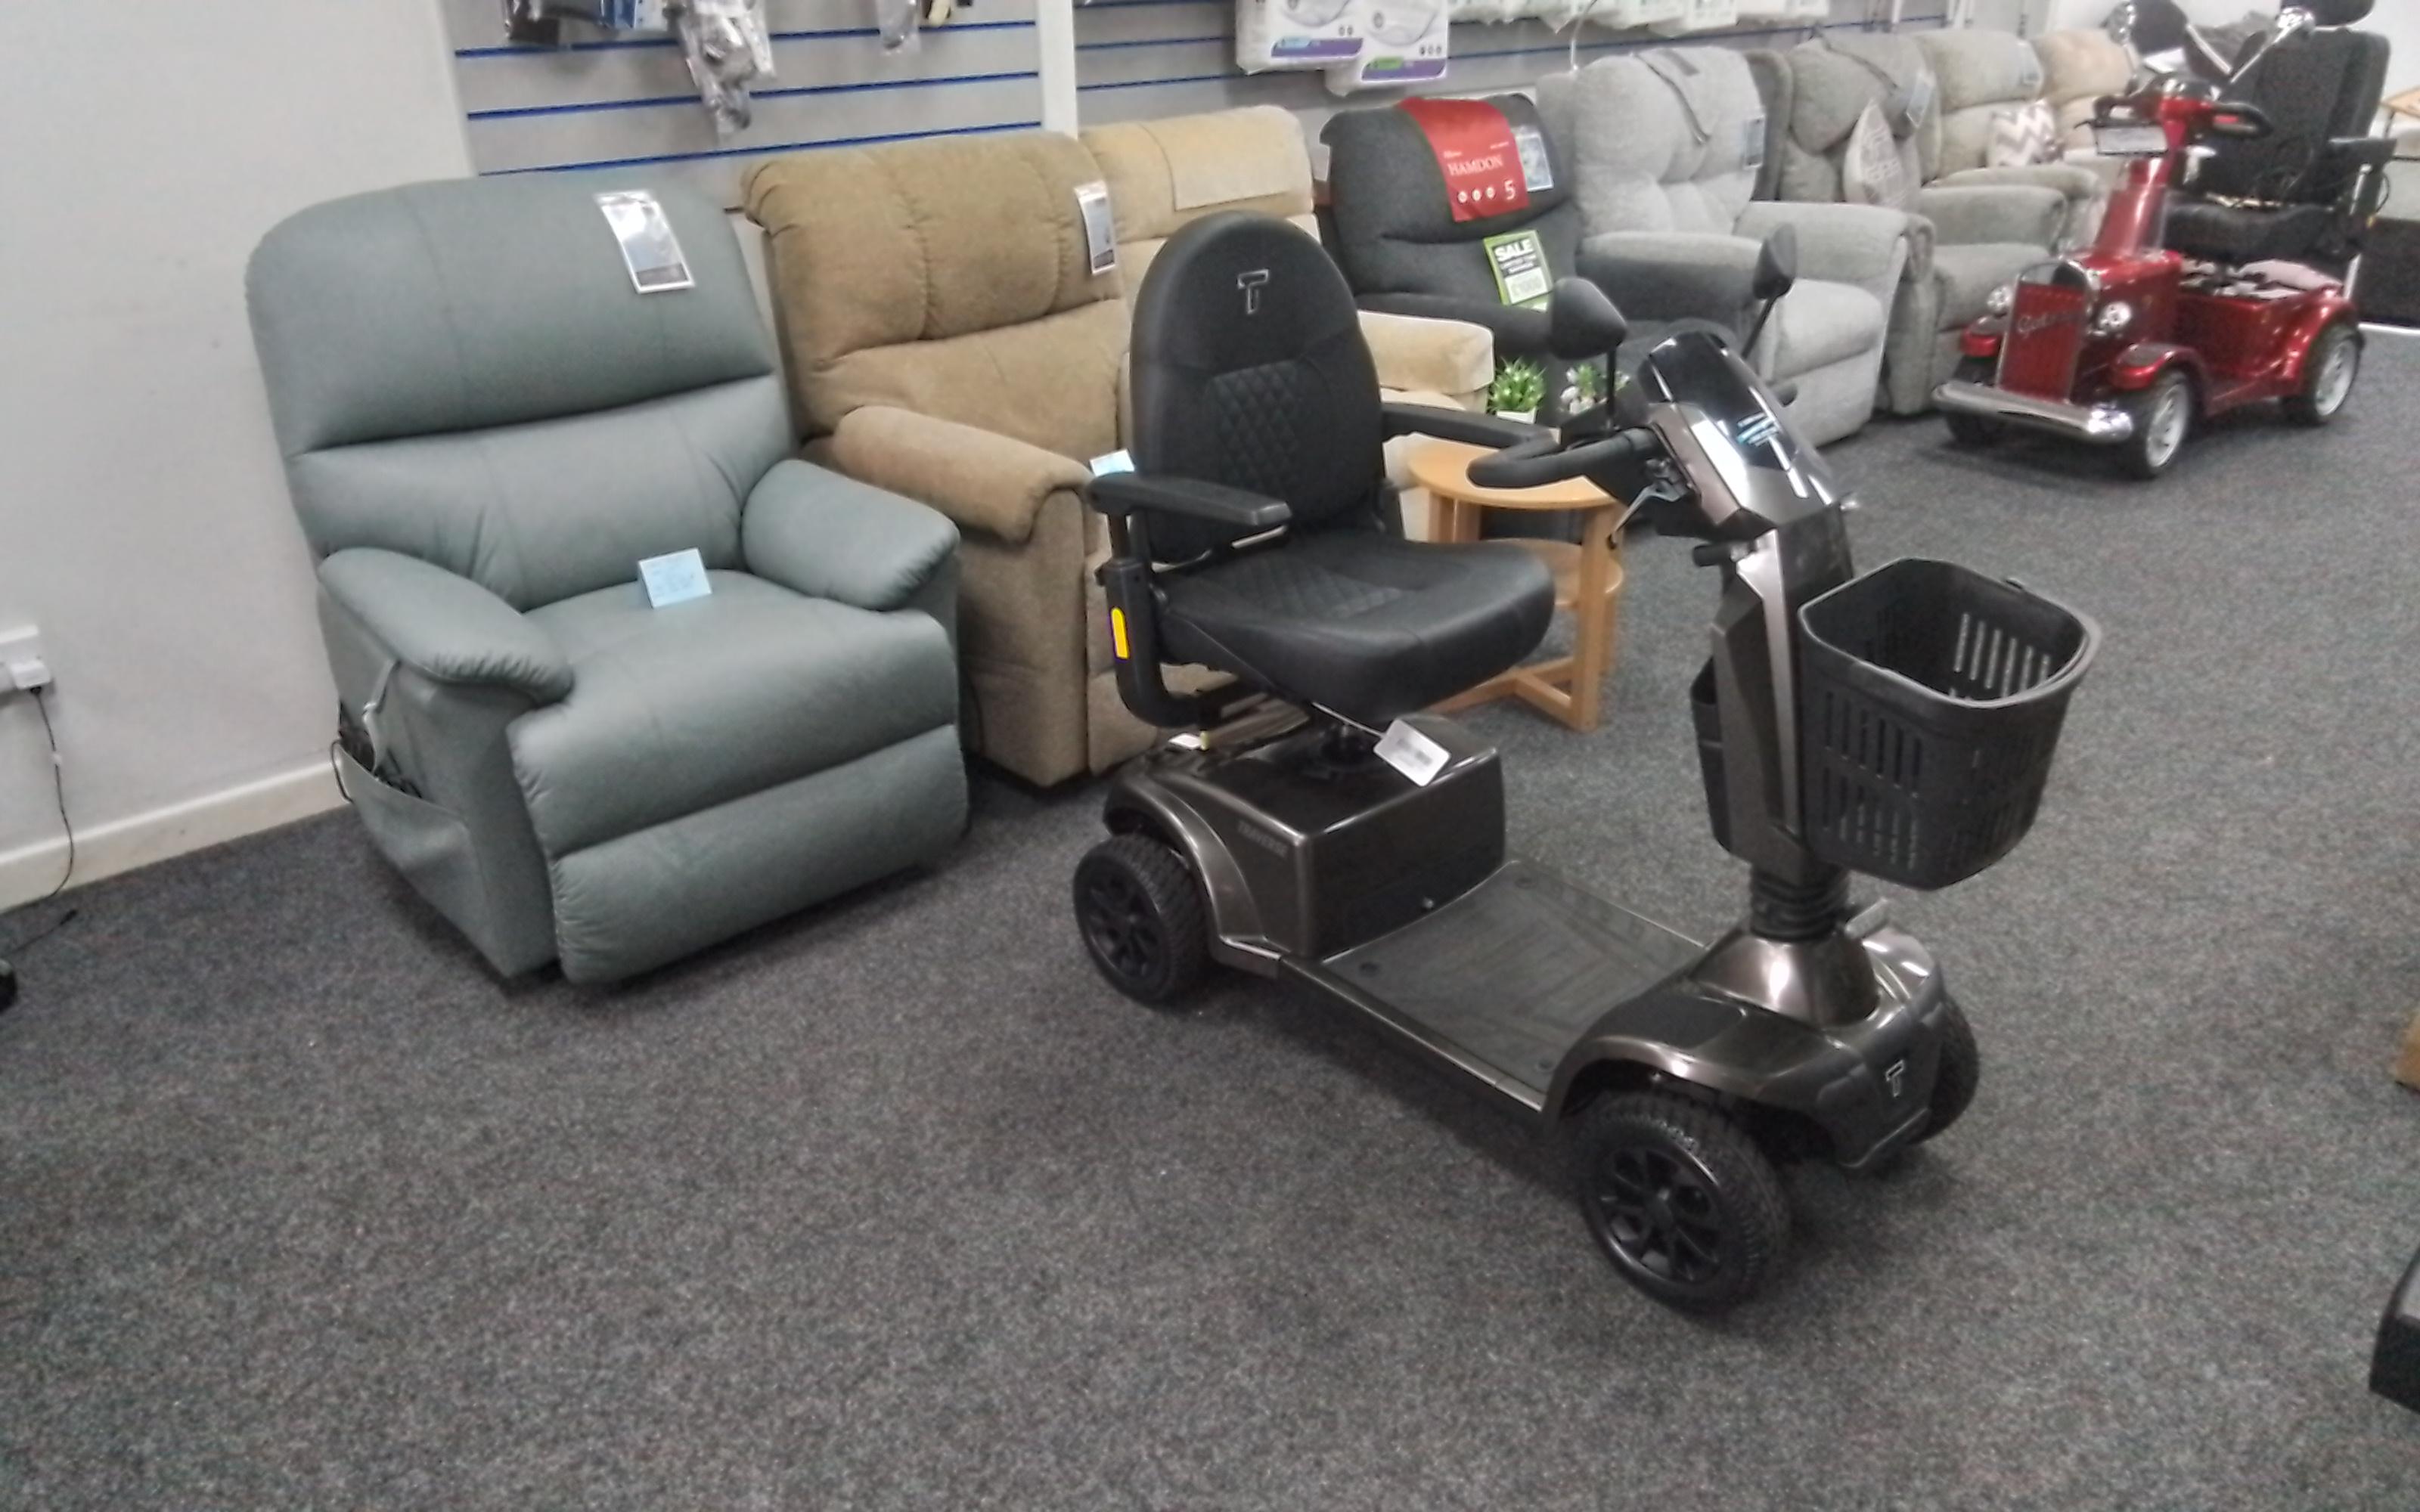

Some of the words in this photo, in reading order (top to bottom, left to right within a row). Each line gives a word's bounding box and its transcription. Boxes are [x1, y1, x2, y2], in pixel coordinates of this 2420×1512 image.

[1447, 153, 1503, 176] HAMDON
[1503, 179, 1516, 200] 5
[1494, 239, 1534, 262] SALE
